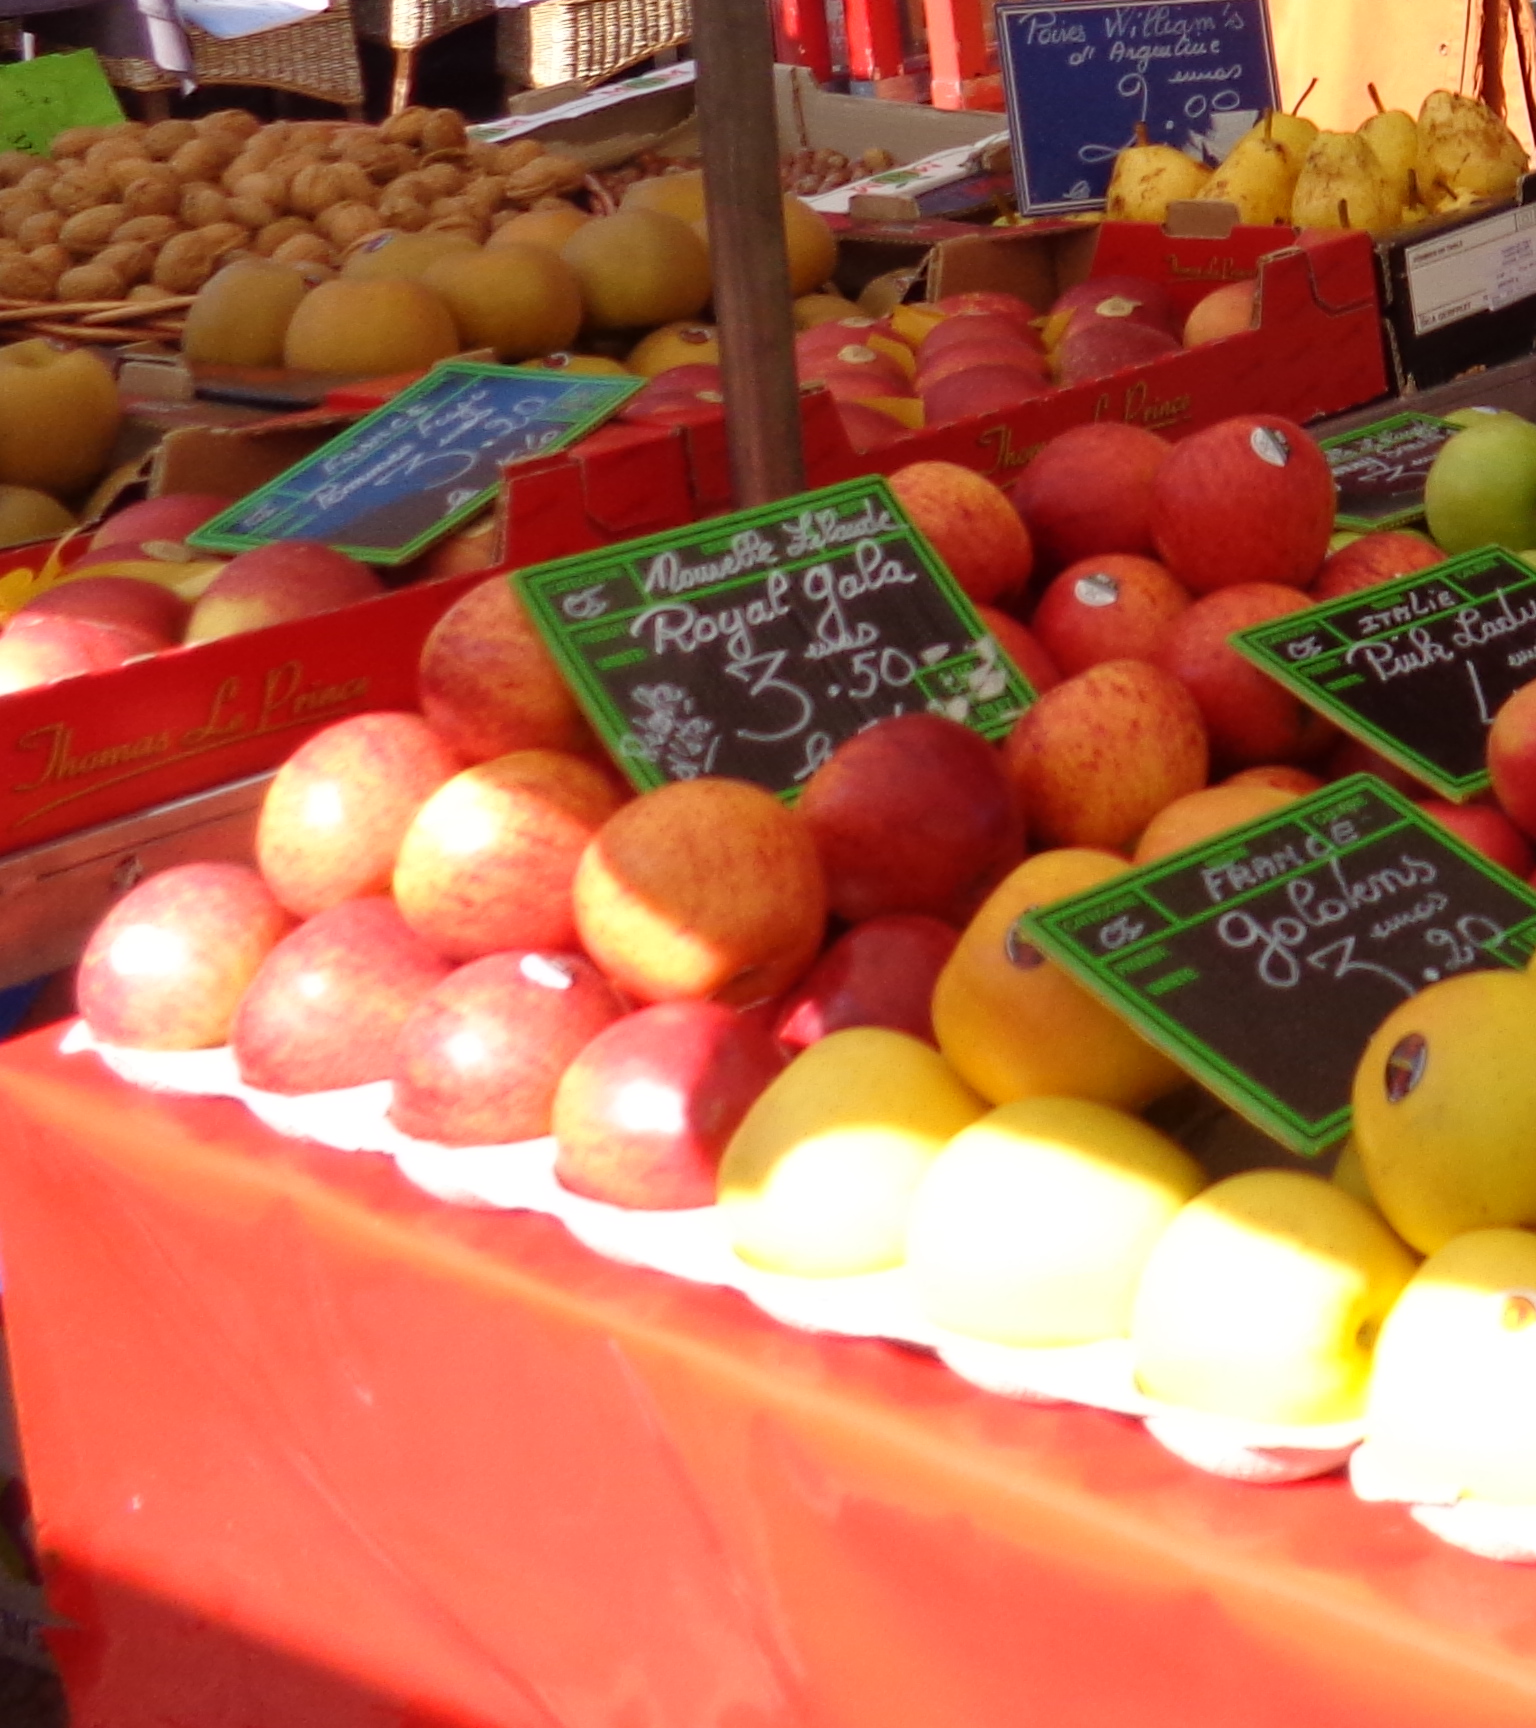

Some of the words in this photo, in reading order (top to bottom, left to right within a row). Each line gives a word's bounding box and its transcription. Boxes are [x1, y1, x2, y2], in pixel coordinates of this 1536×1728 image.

[631, 570, 792, 662] Royal
[1346, 626, 1455, 682] Pink
[1202, 820, 1362, 902] FRANCE
